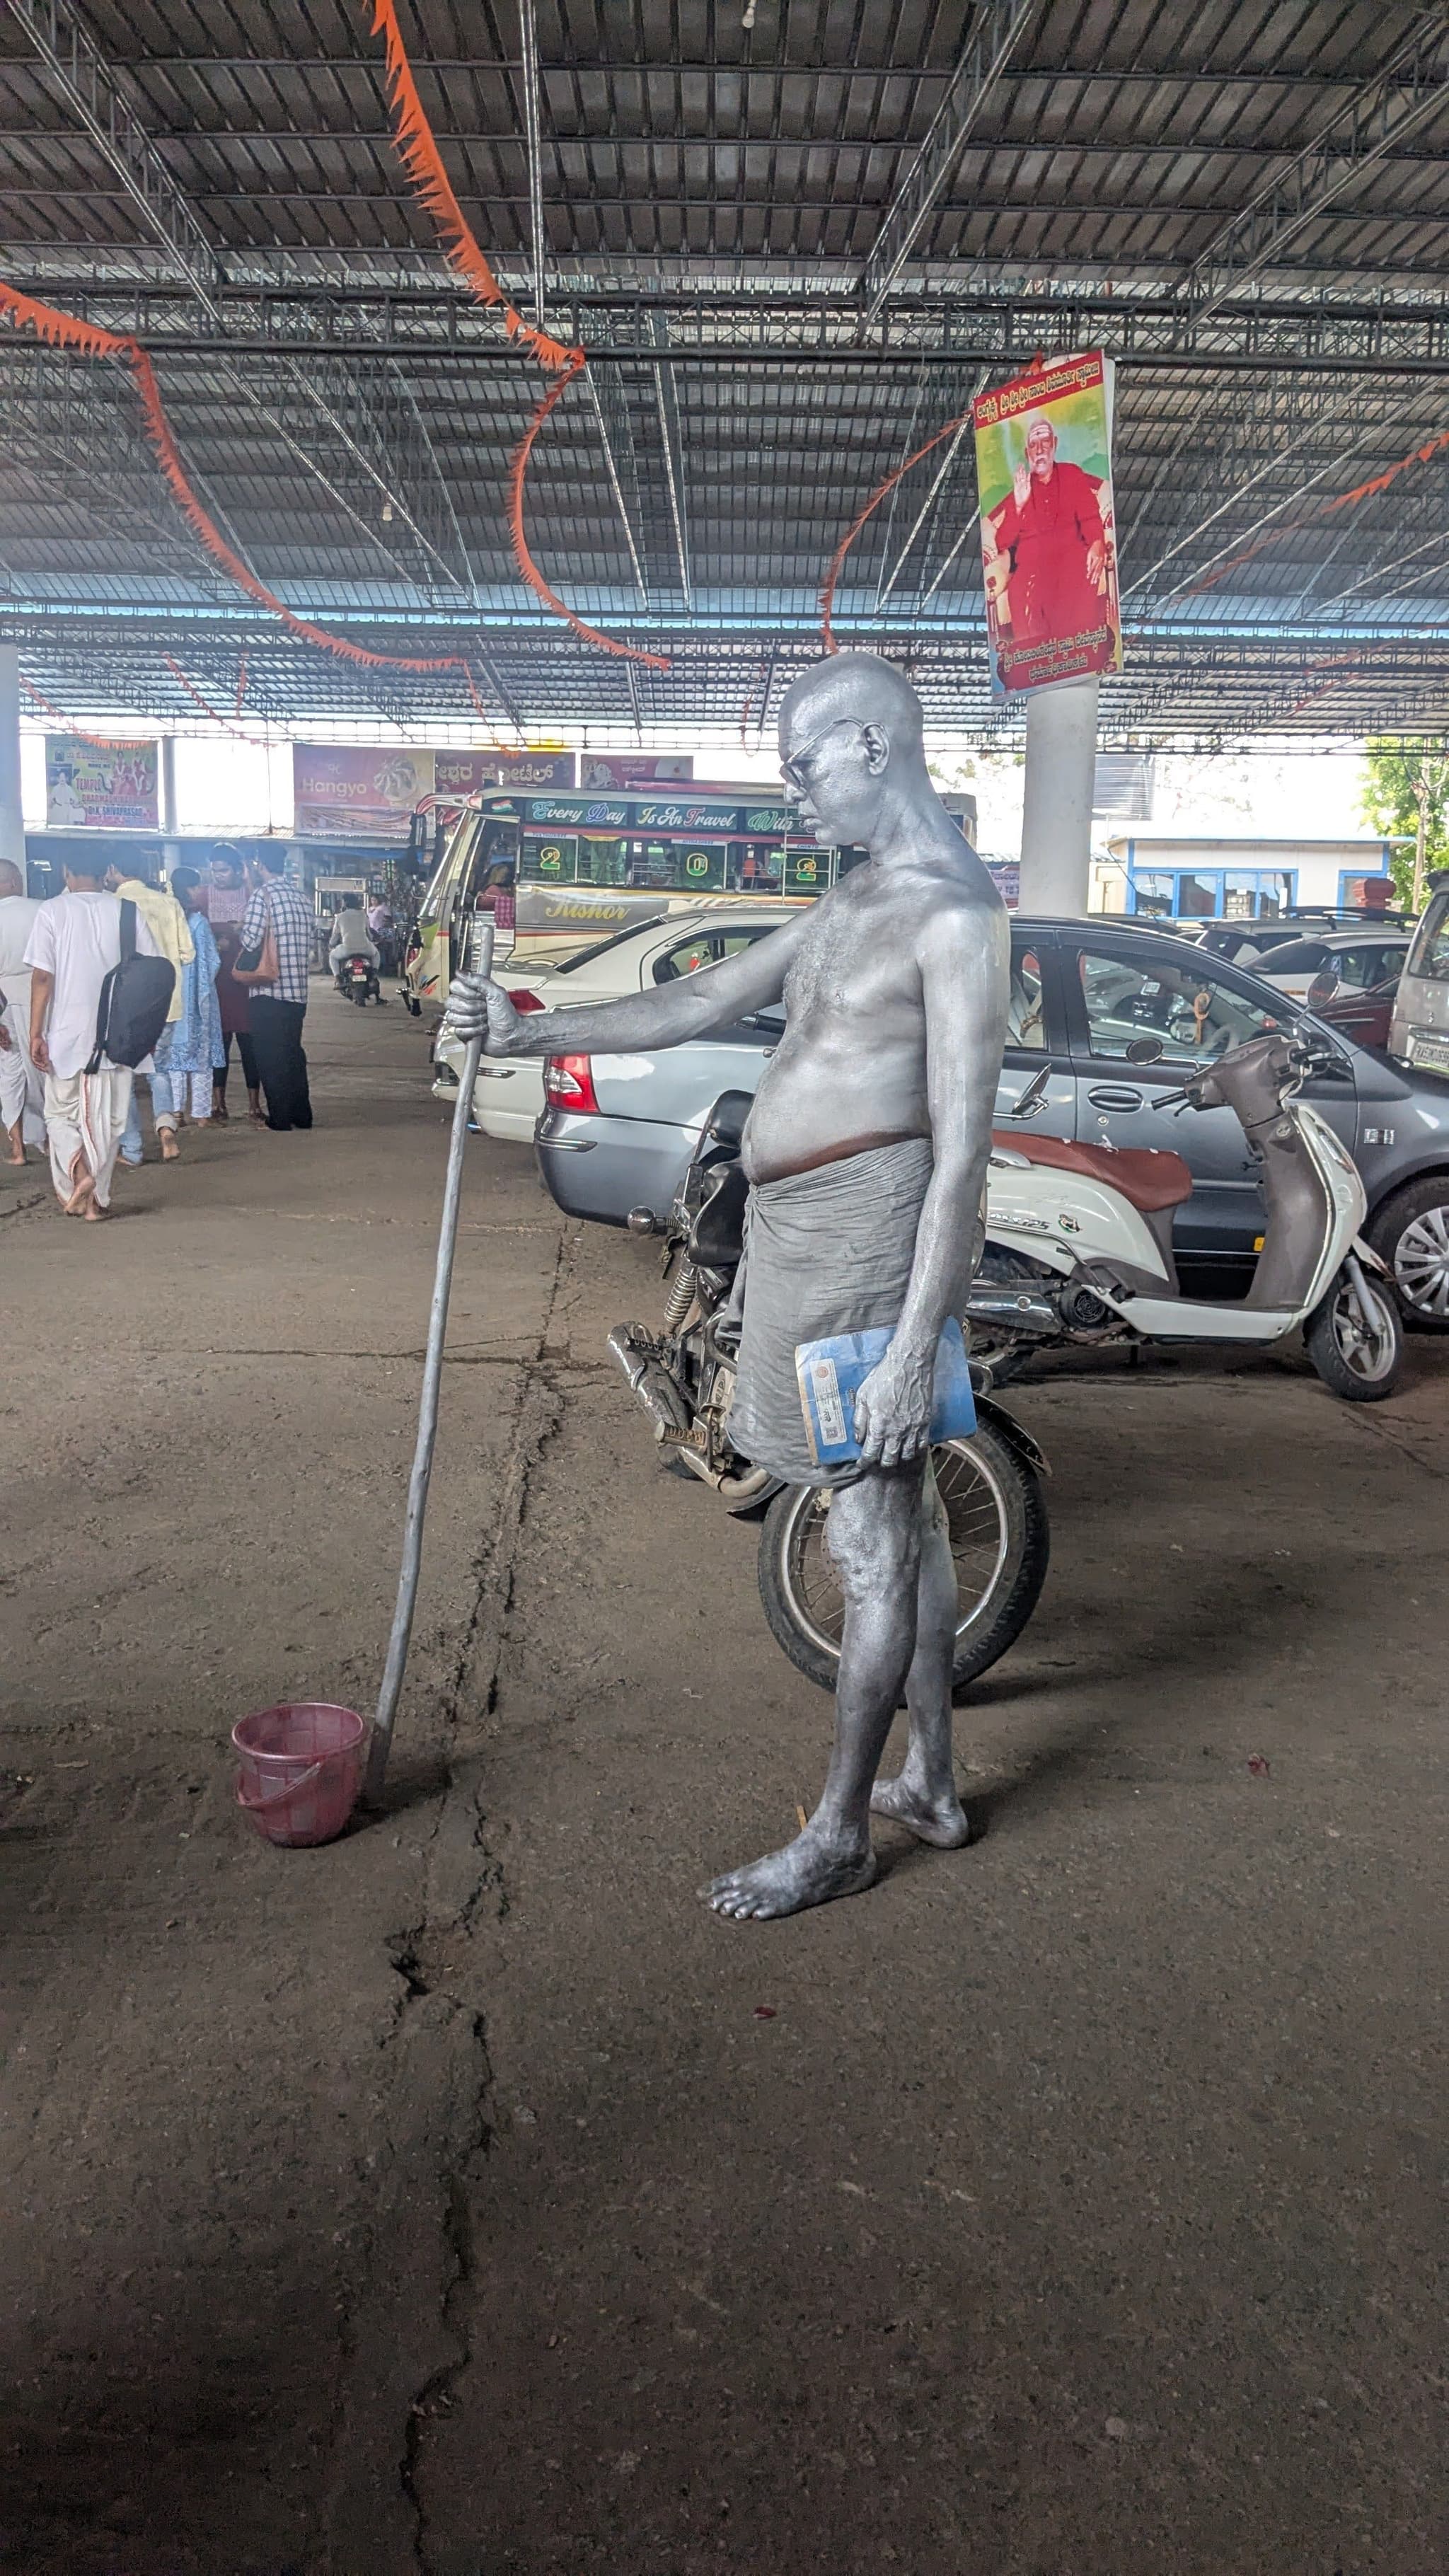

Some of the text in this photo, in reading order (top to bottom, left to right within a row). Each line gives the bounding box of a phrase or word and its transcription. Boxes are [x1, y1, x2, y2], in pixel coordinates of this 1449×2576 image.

[302, 777, 366, 797] Hangyo
[532, 801, 583, 822] Every
[586, 802, 625, 825] Day
[637, 807, 657, 825] Is
[657, 807, 683, 826] An
[683, 807, 736, 827] Travel
[541, 847, 560, 870] 2
[796, 858, 816, 881] 2
